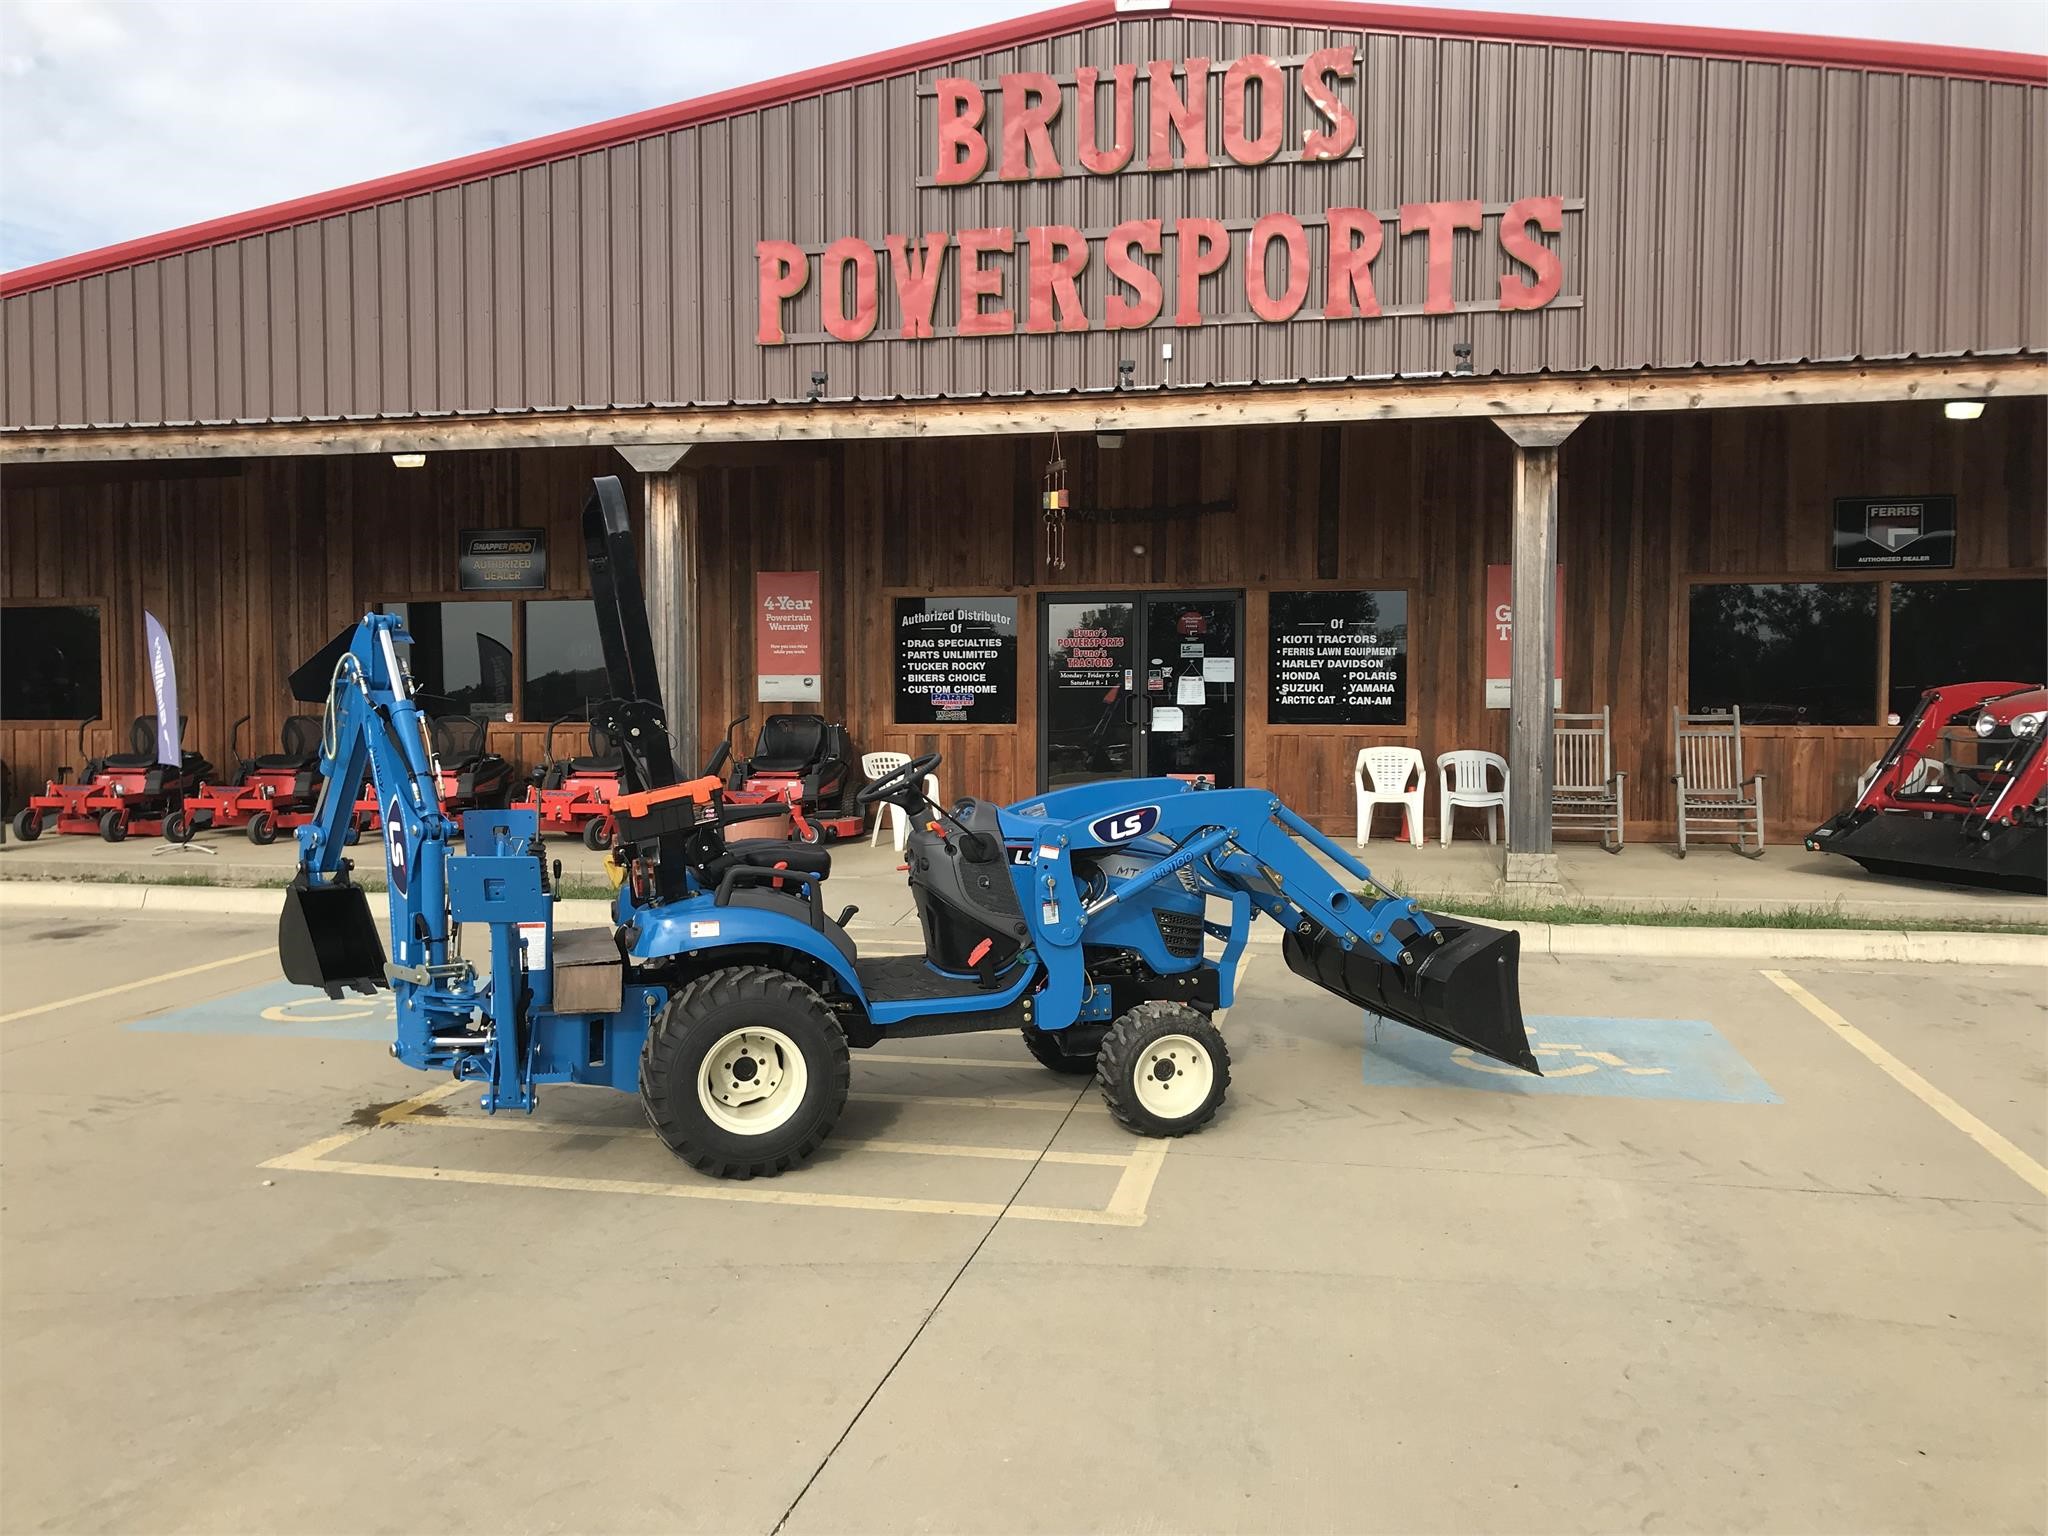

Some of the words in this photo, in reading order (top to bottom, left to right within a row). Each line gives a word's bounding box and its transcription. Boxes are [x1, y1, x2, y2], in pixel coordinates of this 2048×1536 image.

[935, 46, 1359, 187] BRUNOS
[756, 196, 1565, 346] POWERSPORTS
[1870, 506, 1920, 517] FERRIS
[473, 543, 508, 551] SNAPPER
[508, 542, 532, 552] PRO
[473, 559, 531, 569] AUTHORIZED
[484, 570, 521, 580] DEALER
[764, 596, 813, 610] 4-Year
[766, 613, 812, 622] Powertrain
[901, 609, 955, 627] Authorized
[957, 609, 1011, 625] Distributor
[950, 623, 963, 634] Of
[1330, 618, 1344, 629] Of
[1073, 627, 1108, 637] Bruno's
[907, 639, 935, 648] DRAG
[937, 638, 1002, 648] SPECIALTIES
[1057, 637, 1125, 648] POWERSPORTS
[1282, 635, 1313, 644] KIOTI
[1316, 635, 1378, 644] TRACTORS
[907, 651, 940, 659] PARTS
[943, 650, 998, 659] UNLIMITED
[1073, 648, 1108, 658] Bruno's
[1282, 647, 1315, 656] FERRIS
[1317, 647, 1341, 656] LAWN
[1343, 647, 1398, 656] EQUIPMENT
[907, 662, 949, 671] TUCKER
[952, 661, 986, 671] ROCKY
[1067, 657, 1114, 668] TRACTORS
[1282, 659, 1325, 668] HARLEY
[1327, 659, 1384, 668] DAVIDSON
[907, 674, 946, 683] BIKERS
[948, 673, 987, 682] CHOICE
[1282, 672, 1321, 680] HONDA
[1349, 671, 1398, 680] POLARIS
[907, 685, 951, 694] CUSTOM
[953, 685, 998, 694] CHROME
[1281, 683, 1324, 692] SUZUKI
[1349, 683, 1395, 692] YAMAHA
[1281, 695, 1315, 705] ARCTIC
[1317, 695, 1336, 705] CAT
[1348, 696, 1392, 705] CAN-AM
[1110, 814, 1142, 840] LS
[388, 821, 405, 867] LS
[1116, 865, 1143, 877] MT
